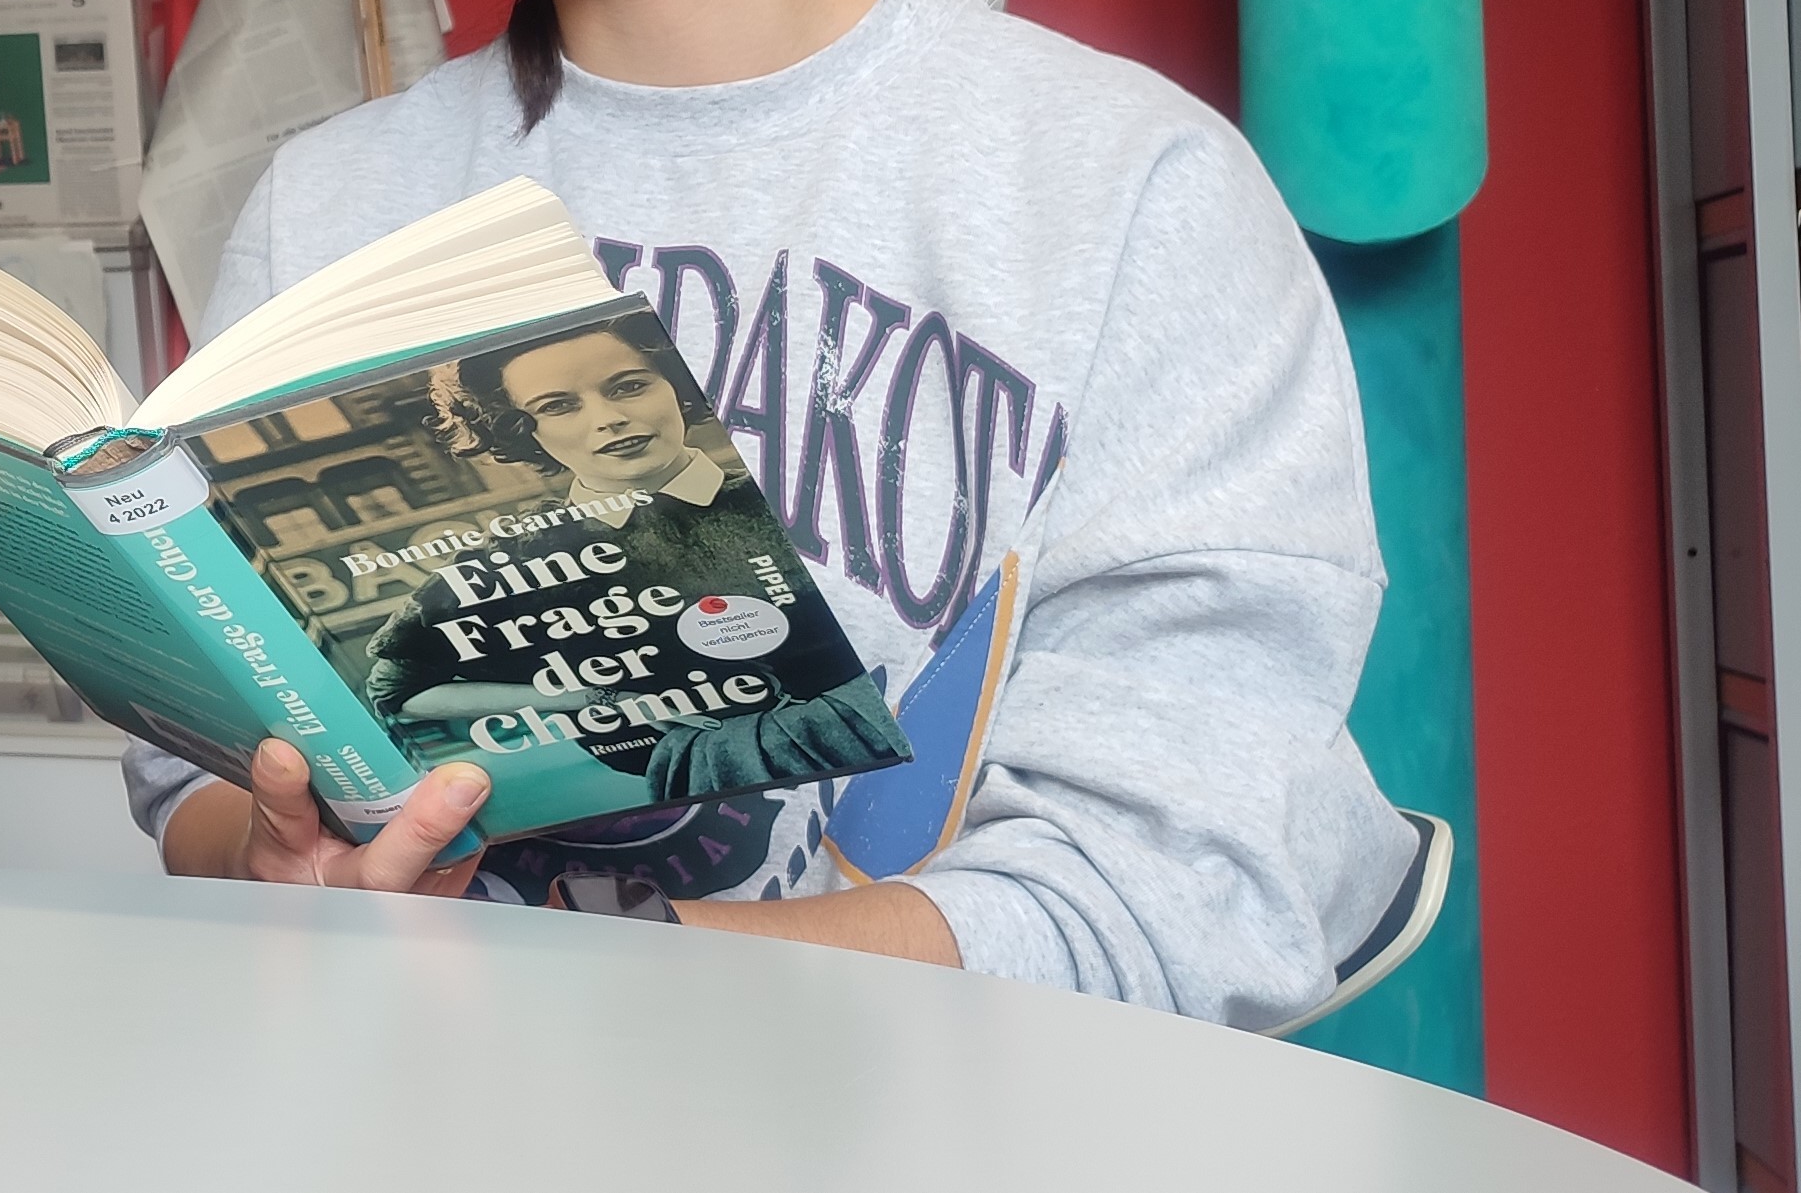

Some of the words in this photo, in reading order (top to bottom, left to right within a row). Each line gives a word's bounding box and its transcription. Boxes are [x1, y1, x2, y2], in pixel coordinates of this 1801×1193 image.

[651, 244, 1069, 653] DAKOT
[104, 489, 145, 507] Neu
[109, 514, 121, 523] 4
[123, 498, 169, 522] 2022
[143, 527, 198, 582] Che
[339, 526, 485, 578] Bonnie
[489, 488, 654, 538] Garmus
[432, 541, 627, 609] Eine
[748, 554, 796, 608] PIPER
[187, 584, 234, 621] der
[433, 585, 686, 663] Frage
[698, 610, 760, 628] Bestseller
[720, 622, 751, 634] nicht
[223, 624, 288, 688] Frage
[701, 626, 779, 647] verlängerbar
[532, 645, 660, 697] der
[277, 689, 327, 736] Eine
[469, 669, 770, 754] Chemie
[337, 744, 392, 799] armus
[589, 736, 657, 757] Roman
